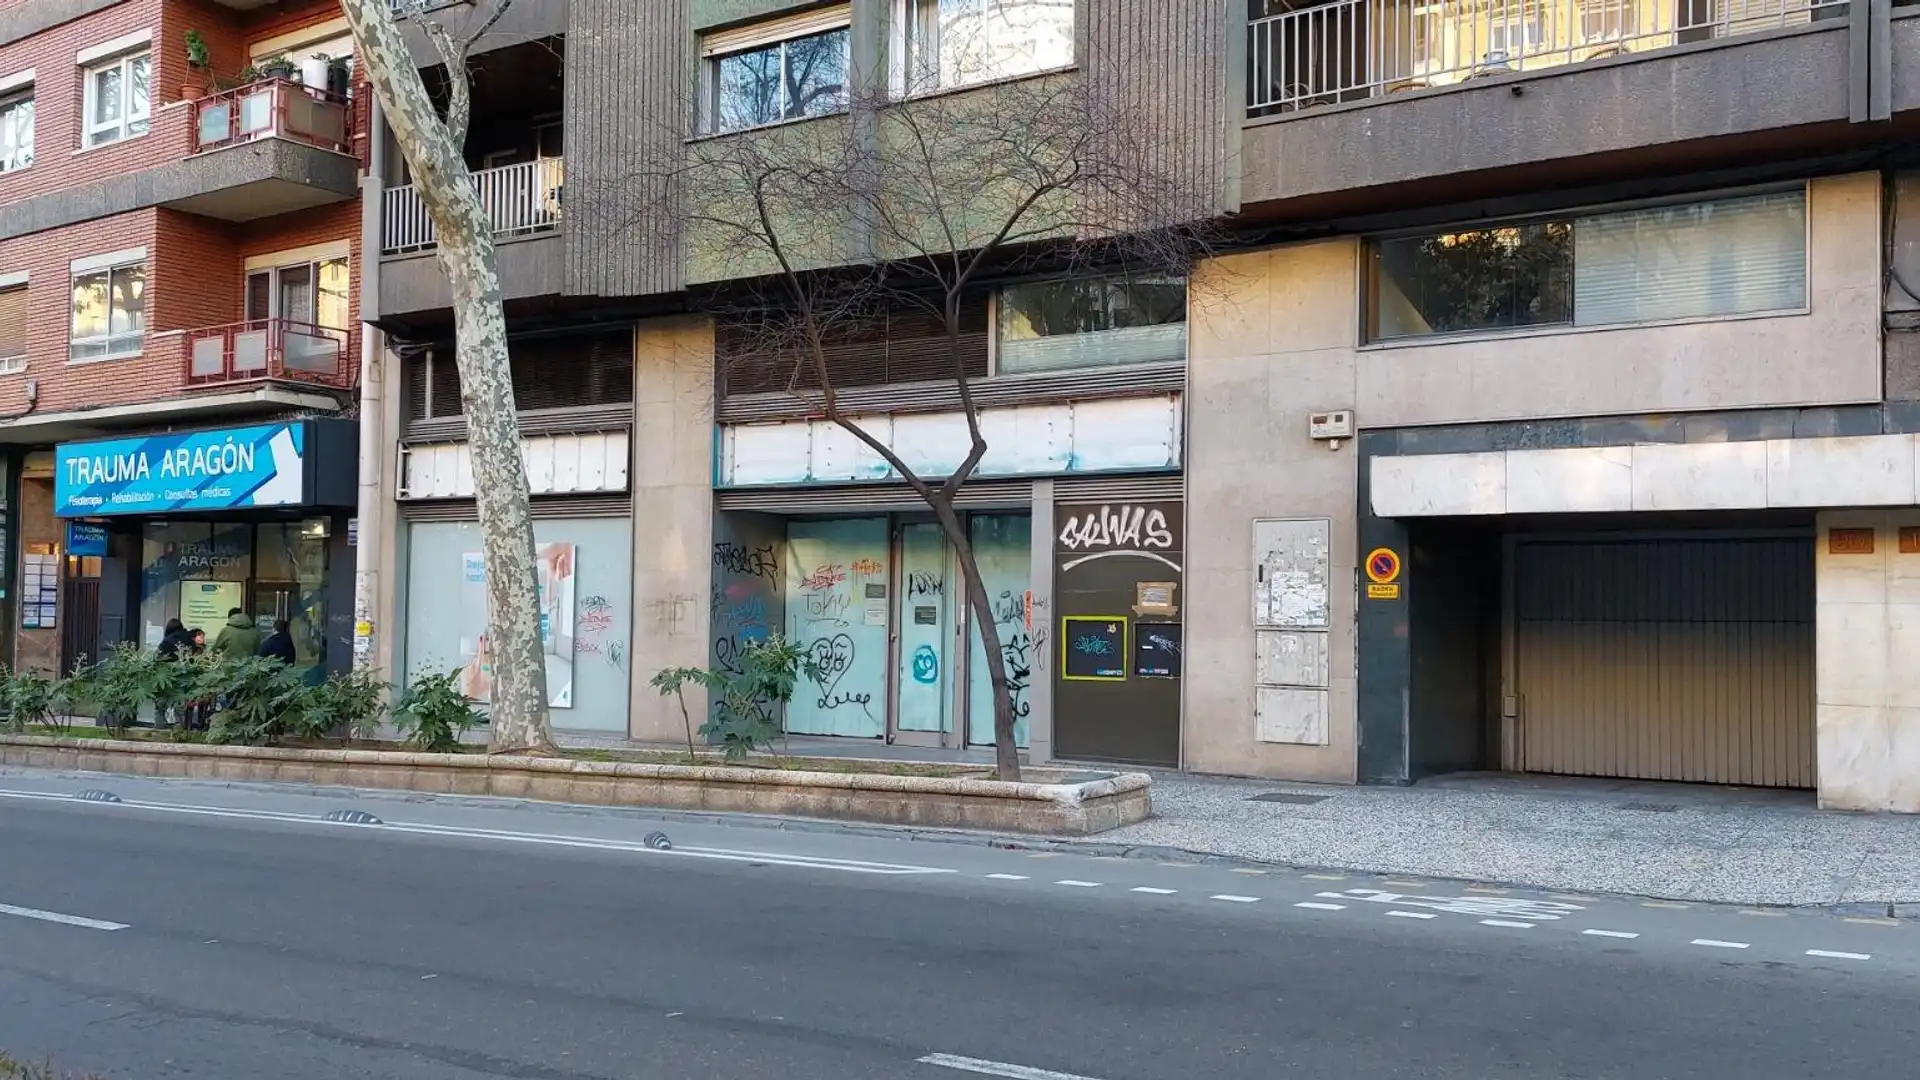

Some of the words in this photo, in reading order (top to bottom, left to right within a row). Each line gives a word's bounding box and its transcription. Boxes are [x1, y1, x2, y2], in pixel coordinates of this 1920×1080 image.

[65, 451, 150, 485] TRAUMA
[160, 436, 254, 479] ARAGÓN
[68, 494, 103, 507] Fisioterapia
[164, 488, 199, 500] Consultas
